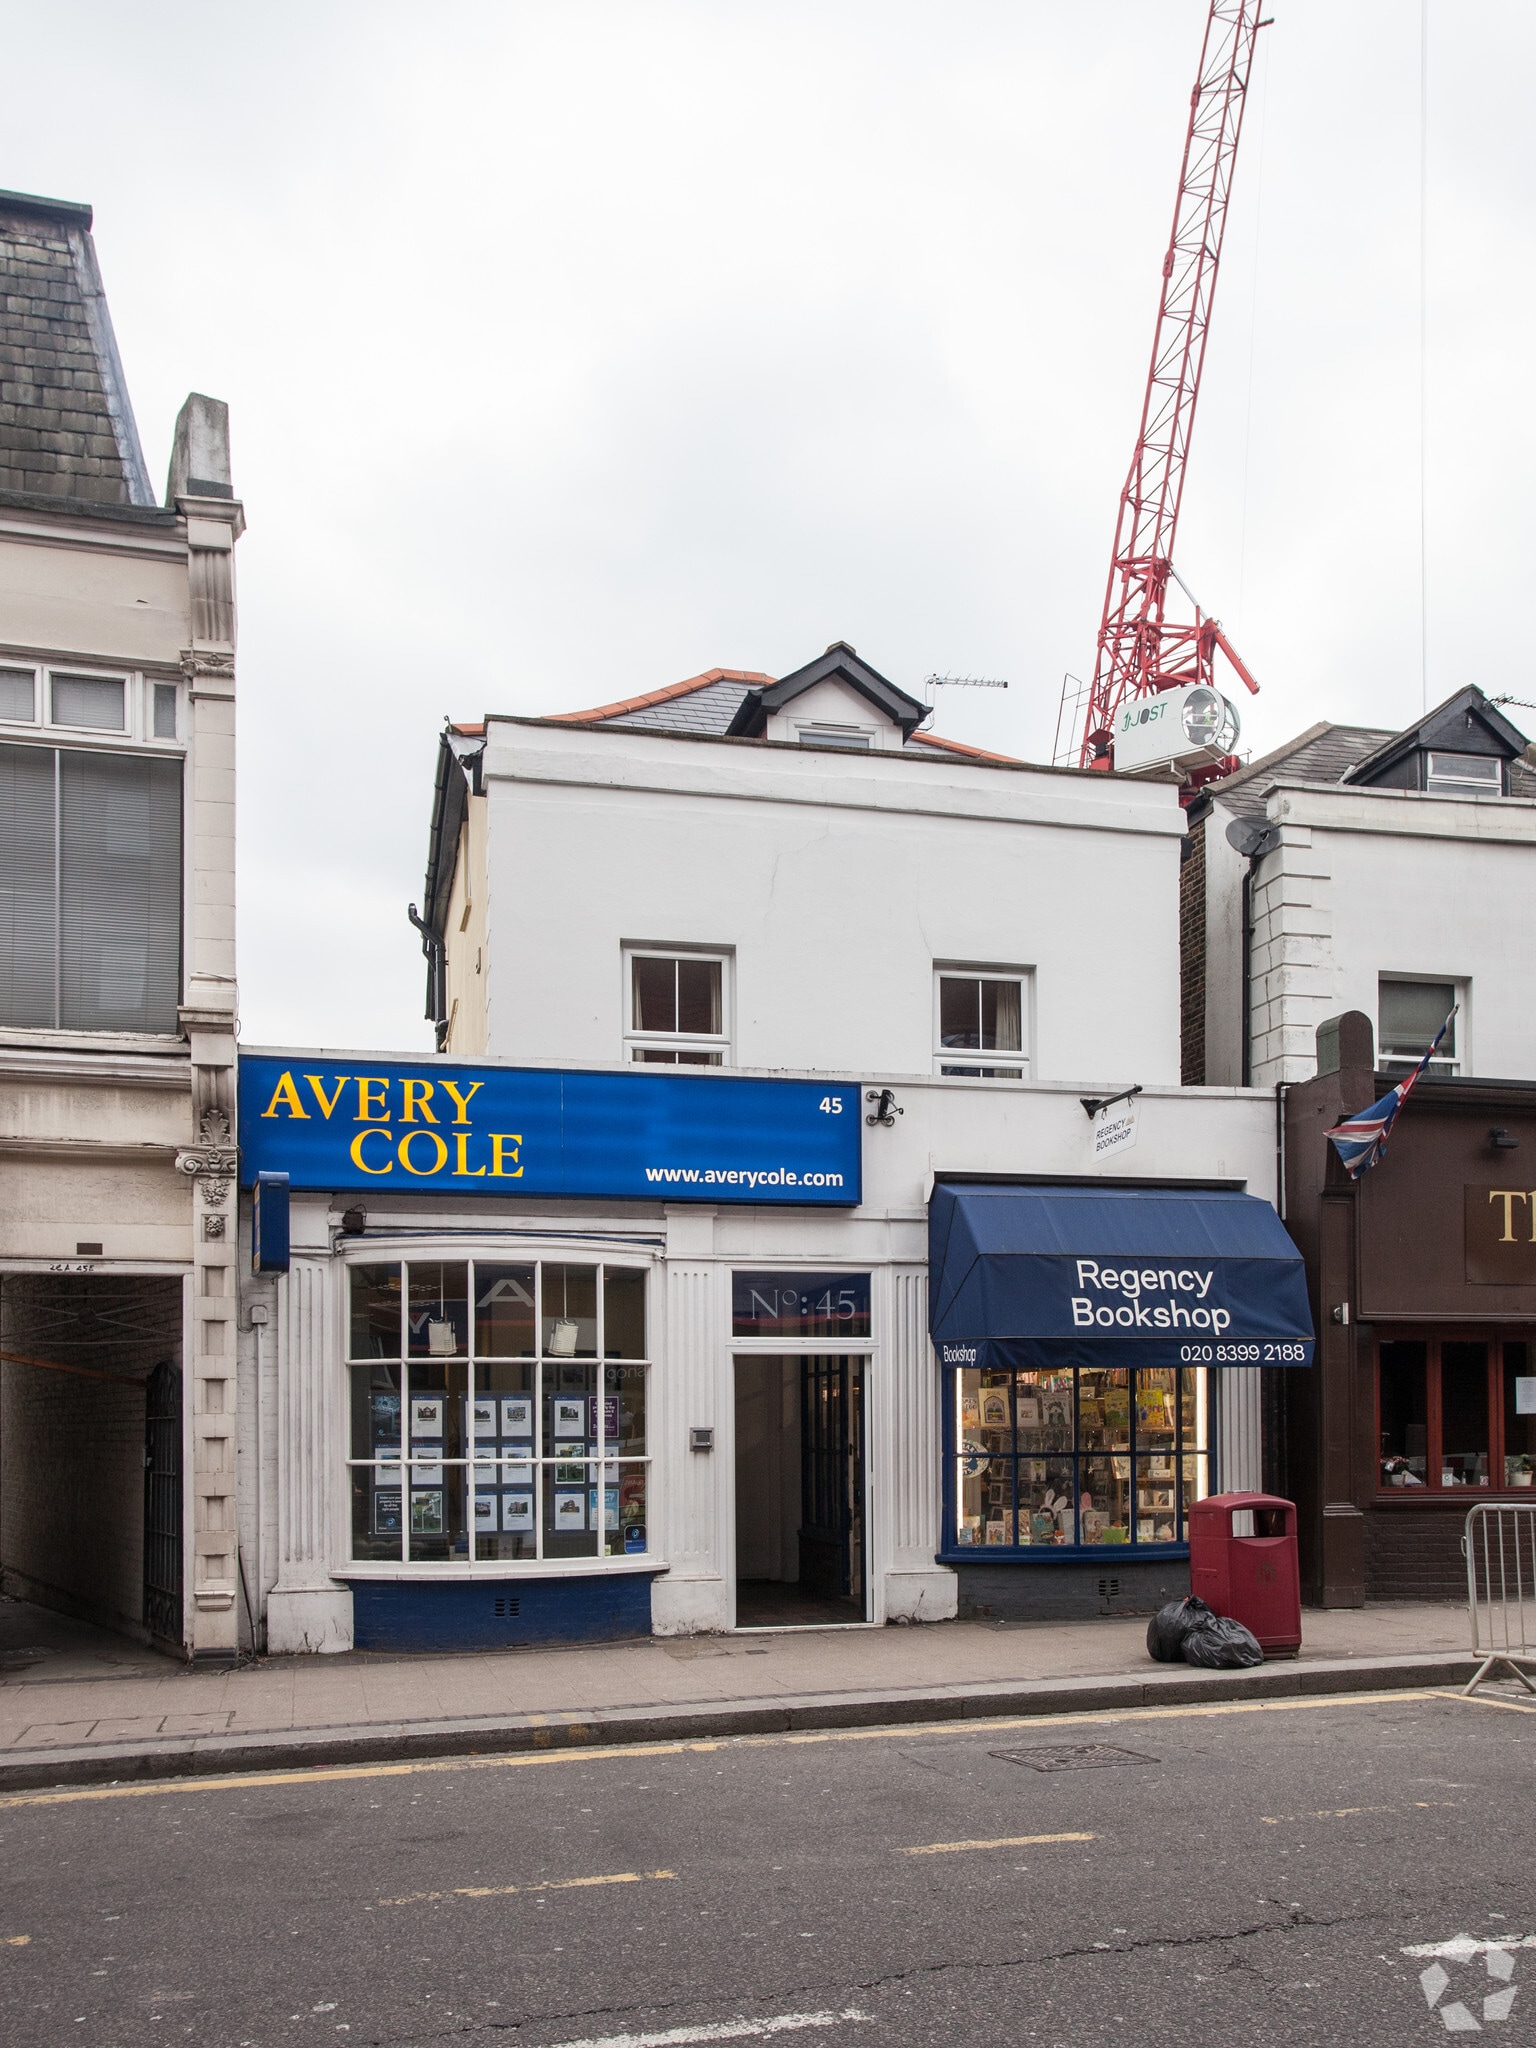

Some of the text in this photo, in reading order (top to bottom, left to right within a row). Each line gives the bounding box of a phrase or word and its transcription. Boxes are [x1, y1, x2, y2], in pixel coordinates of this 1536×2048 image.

[260, 1071, 484, 1125] AVERY
[819, 1096, 843, 1114] 45
[1096, 1117, 1126, 1140] REGENCY
[1096, 1127, 1131, 1152] BOOKSHOP
[349, 1128, 524, 1178] COLE
[645, 1167, 844, 1189] www.averycole.com
[1076, 1259, 1214, 1299] Regency
[1071, 1297, 1231, 1336] Bookshop
[943, 1343, 977, 1364] Bookshop
[1180, 1343, 1305, 1362] 020 8399 2188
